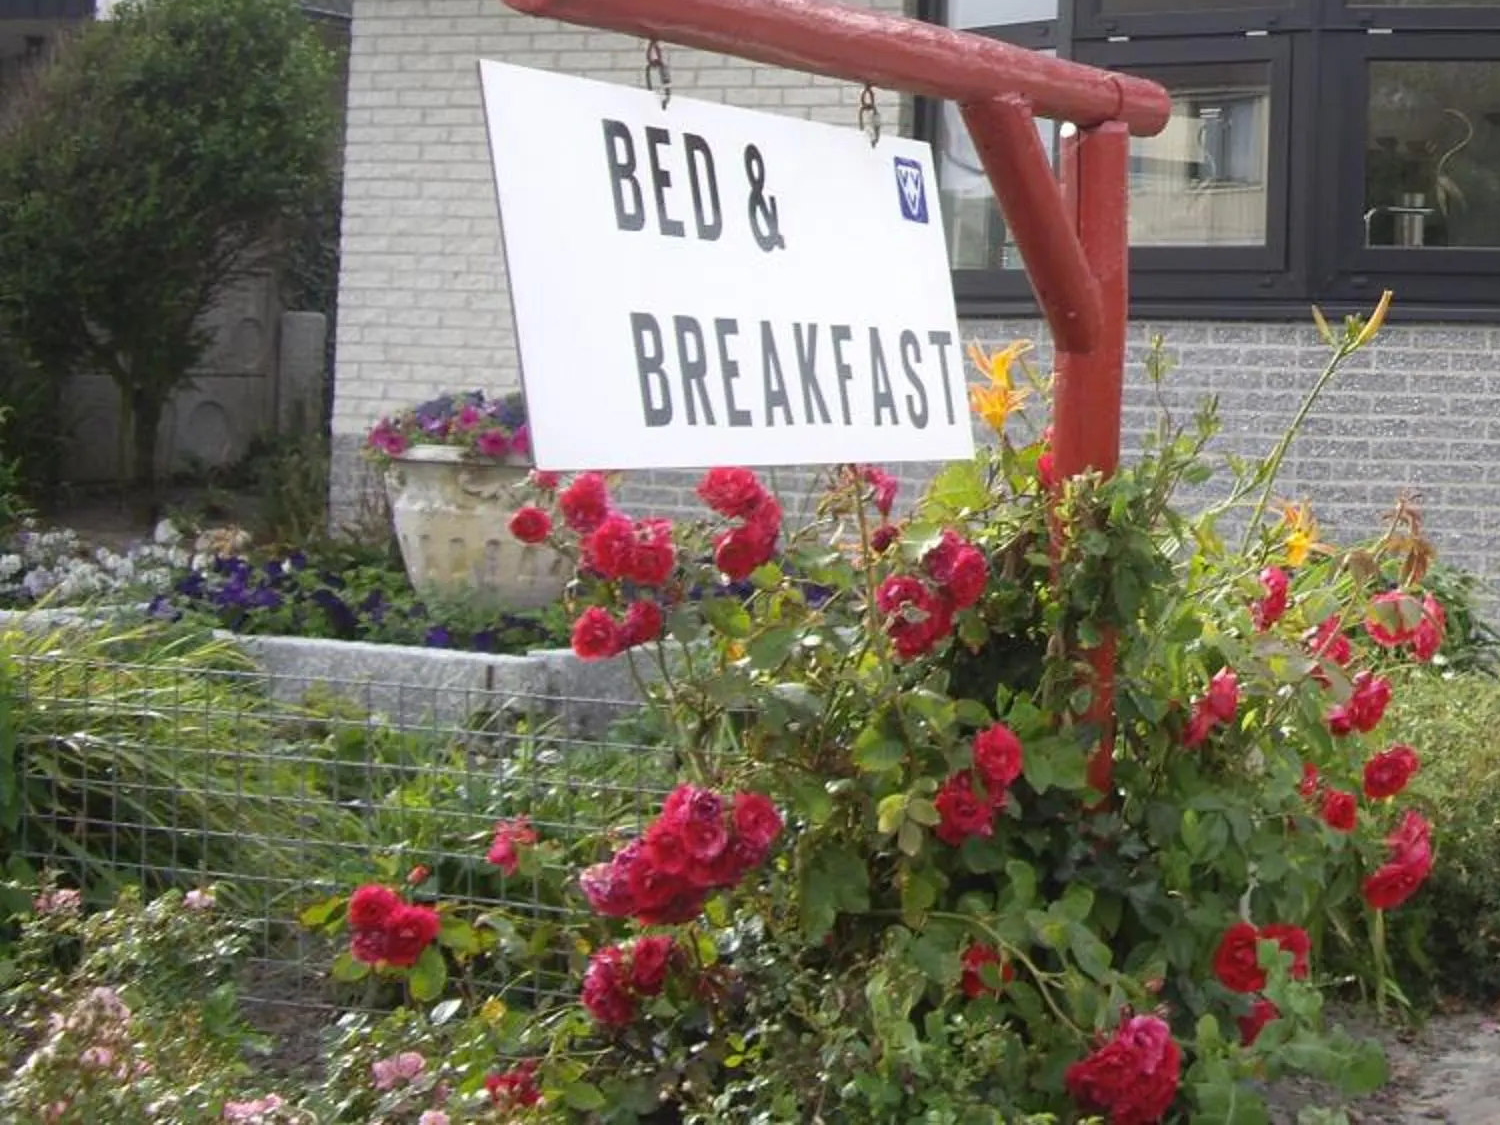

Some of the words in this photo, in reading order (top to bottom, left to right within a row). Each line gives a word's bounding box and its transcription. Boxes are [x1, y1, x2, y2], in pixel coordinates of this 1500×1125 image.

[602, 118, 723, 242] BED
[743, 143, 786, 252] &
[629, 312, 957, 429] BREAKFAST
